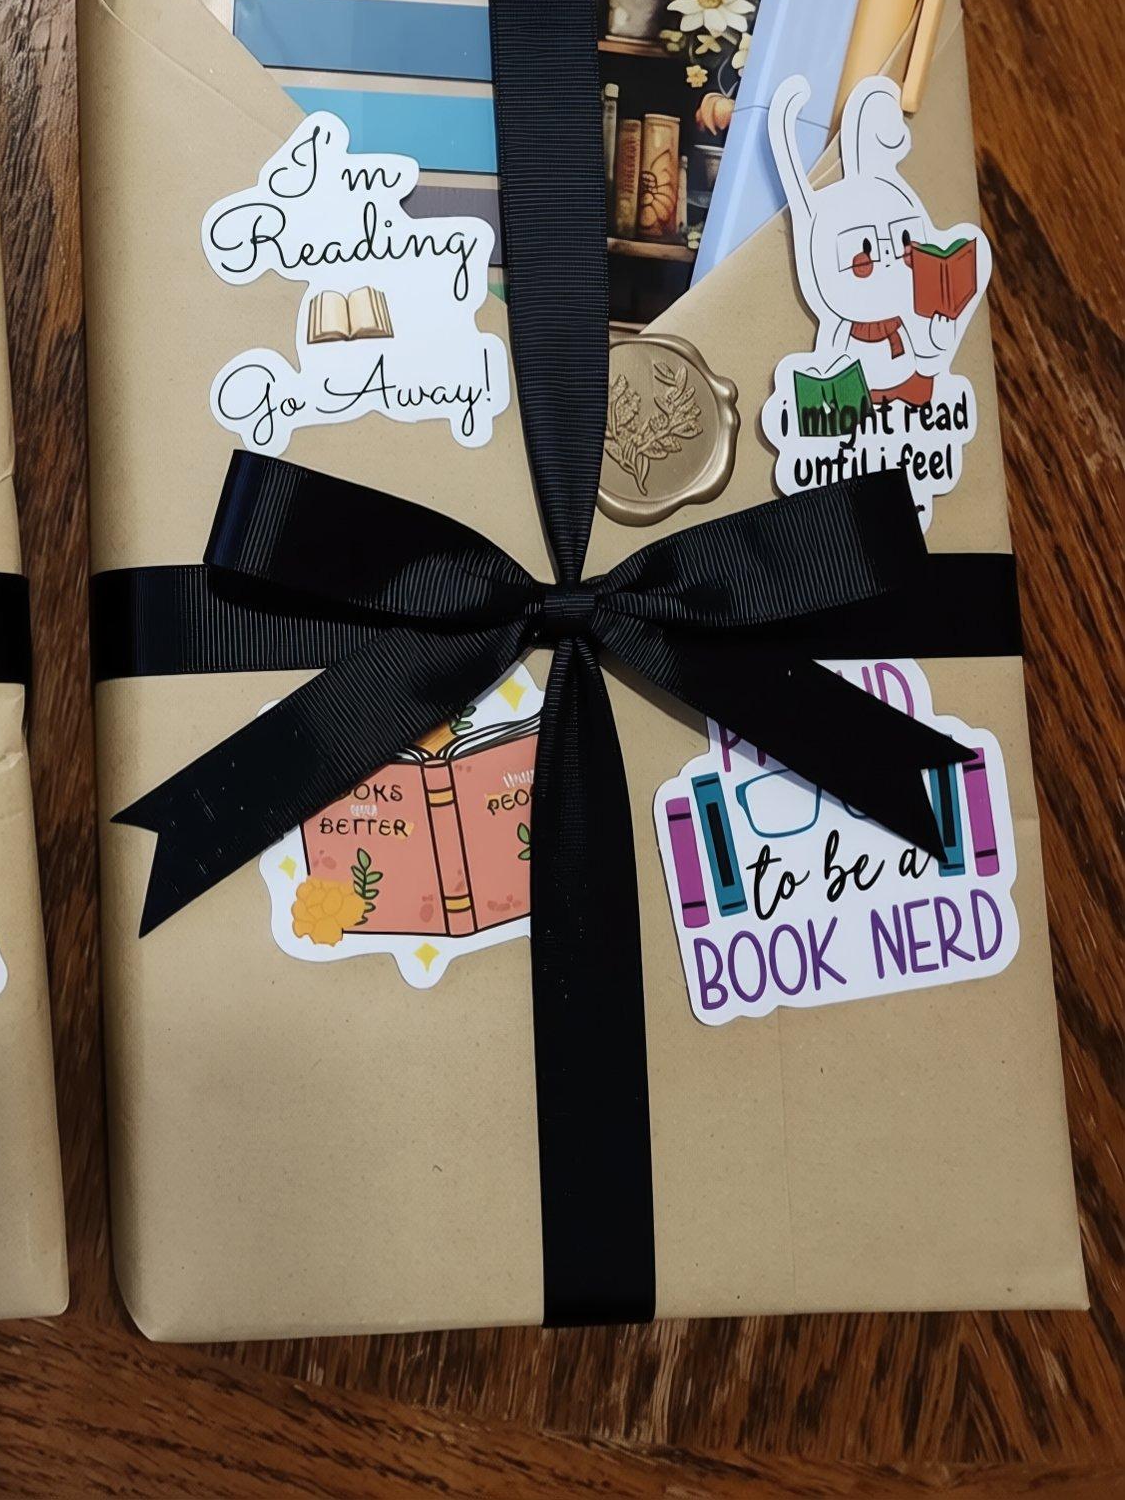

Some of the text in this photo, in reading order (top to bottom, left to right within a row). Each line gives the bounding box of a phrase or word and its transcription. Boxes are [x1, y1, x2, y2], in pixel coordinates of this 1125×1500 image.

[268, 125, 401, 198] I'm
[209, 201, 478, 302] Reading
[217, 348, 493, 446] Go Away!
[801, 394, 895, 451] might
[903, 390, 969, 434] read
[794, 446, 868, 488] until
[895, 442, 953, 481] feel
[340, 783, 404, 803] OKS
[486, 788, 533, 816] PEO
[319, 818, 409, 838] BETTER
[745, 828, 931, 921] to be a
[693, 888, 1004, 1012] BOOK NERD
